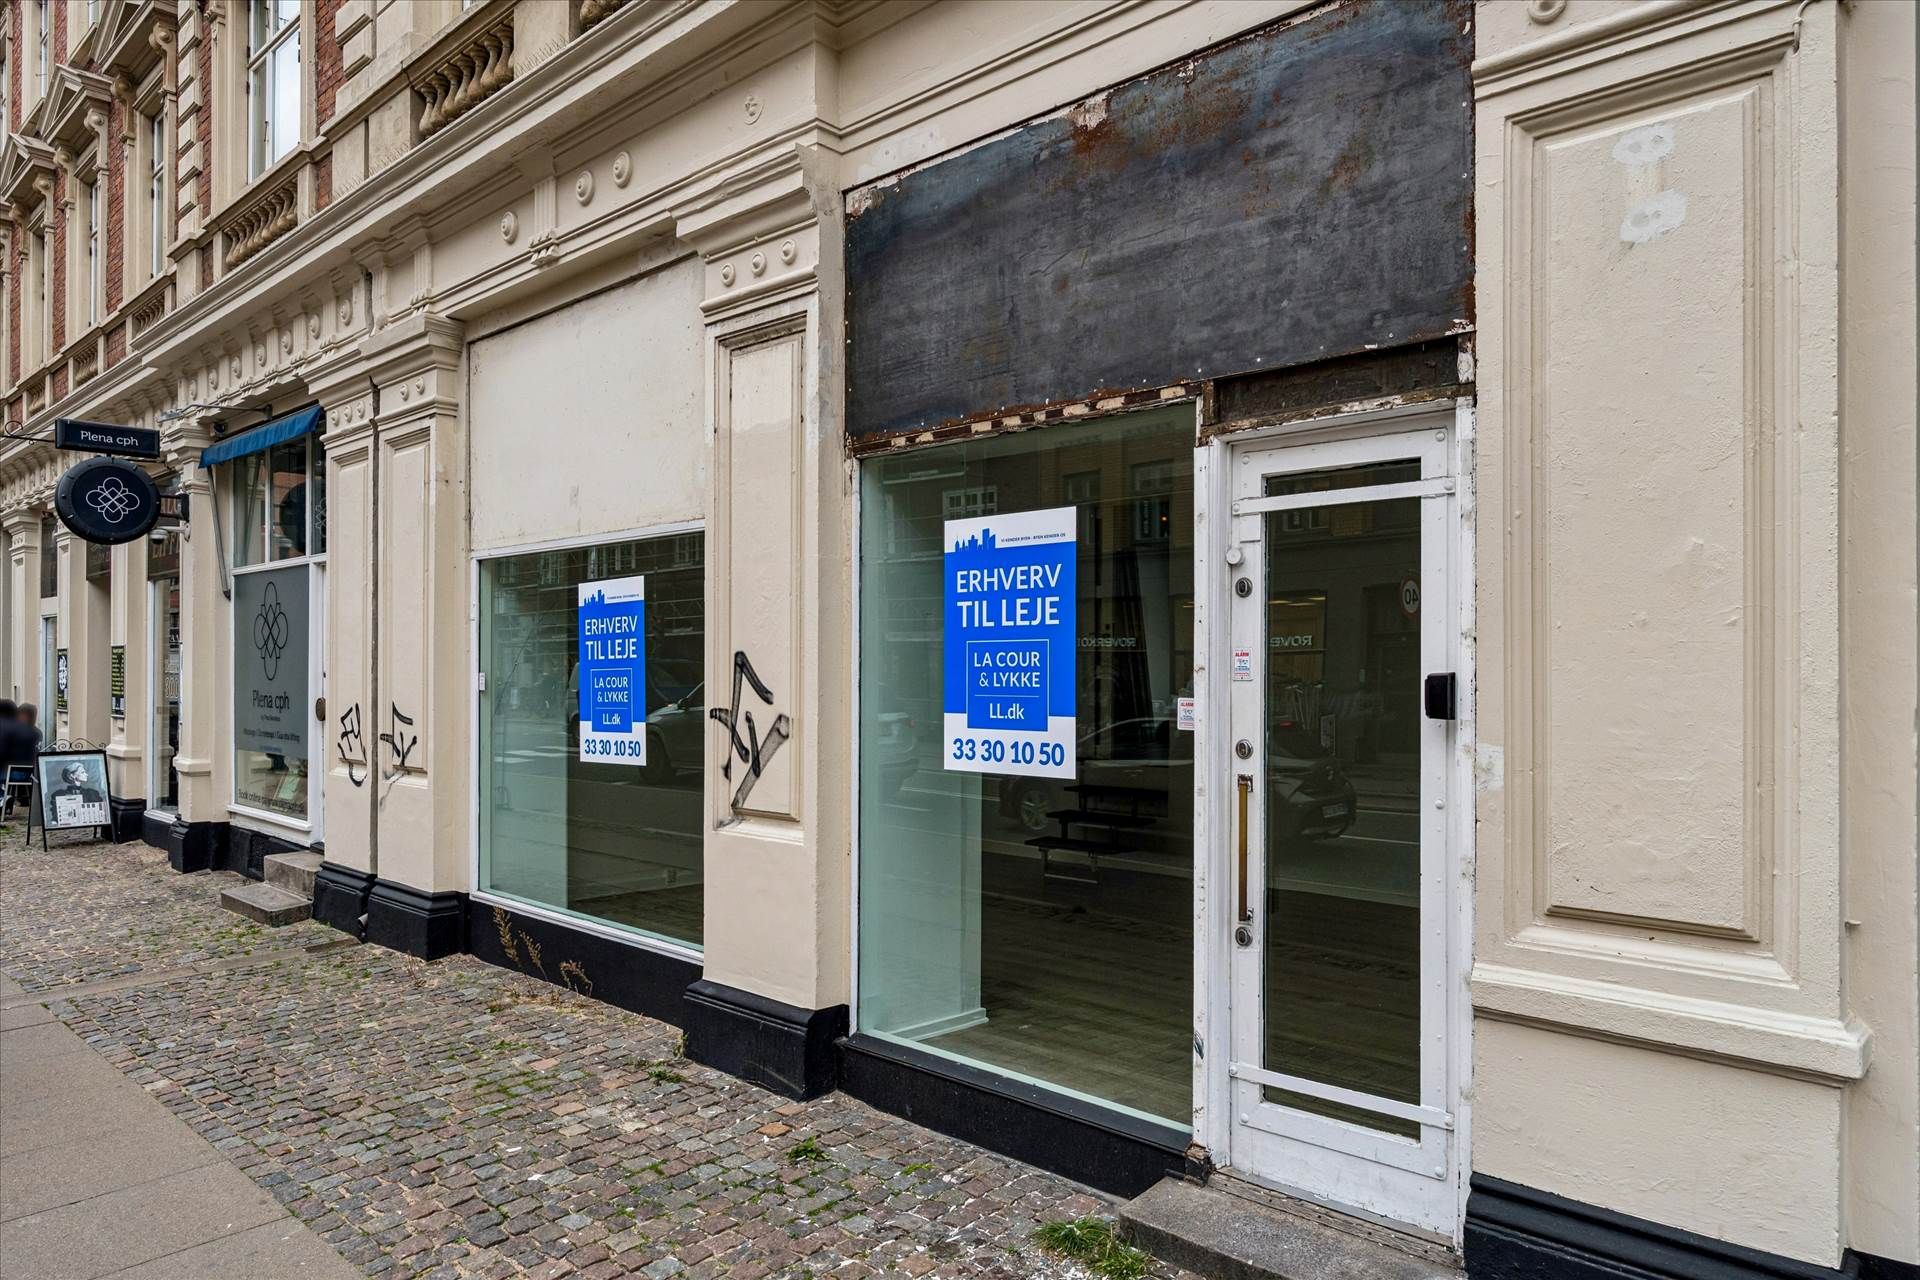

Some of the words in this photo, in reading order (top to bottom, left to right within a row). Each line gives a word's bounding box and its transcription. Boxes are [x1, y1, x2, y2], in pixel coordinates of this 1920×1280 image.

[80, 430, 113, 443] Plena
[116, 436, 139, 447] cph
[956, 563, 1063, 593] ERHVERV
[957, 600, 995, 628] TIL
[1001, 596, 1060, 627] LEJE
[584, 615, 638, 636] ERHVERV
[585, 640, 605, 661] TIL
[608, 638, 637, 659] LEJE
[974, 652, 992, 668] LA
[996, 651, 1041, 667] COUR
[594, 677, 605, 689] LA
[606, 676, 628, 688] COUR
[979, 672, 989, 687] &
[993, 671, 1041, 687] LYKKE
[274, 690, 290, 714] cph
[597, 691, 603, 702] &
[604, 690, 629, 703] LYKKE
[602, 713, 621, 726] LL.dk
[989, 702, 1024, 720] LL.dk
[584, 738, 597, 755] 33
[599, 739, 612, 756] 30
[614, 739, 627, 757] 10
[628, 740, 641, 758] 50
[952, 737, 976, 761] 33
[980, 739, 1005, 763] 30
[1010, 741, 1035, 765] 10
[1038, 742, 1065, 767] 50
